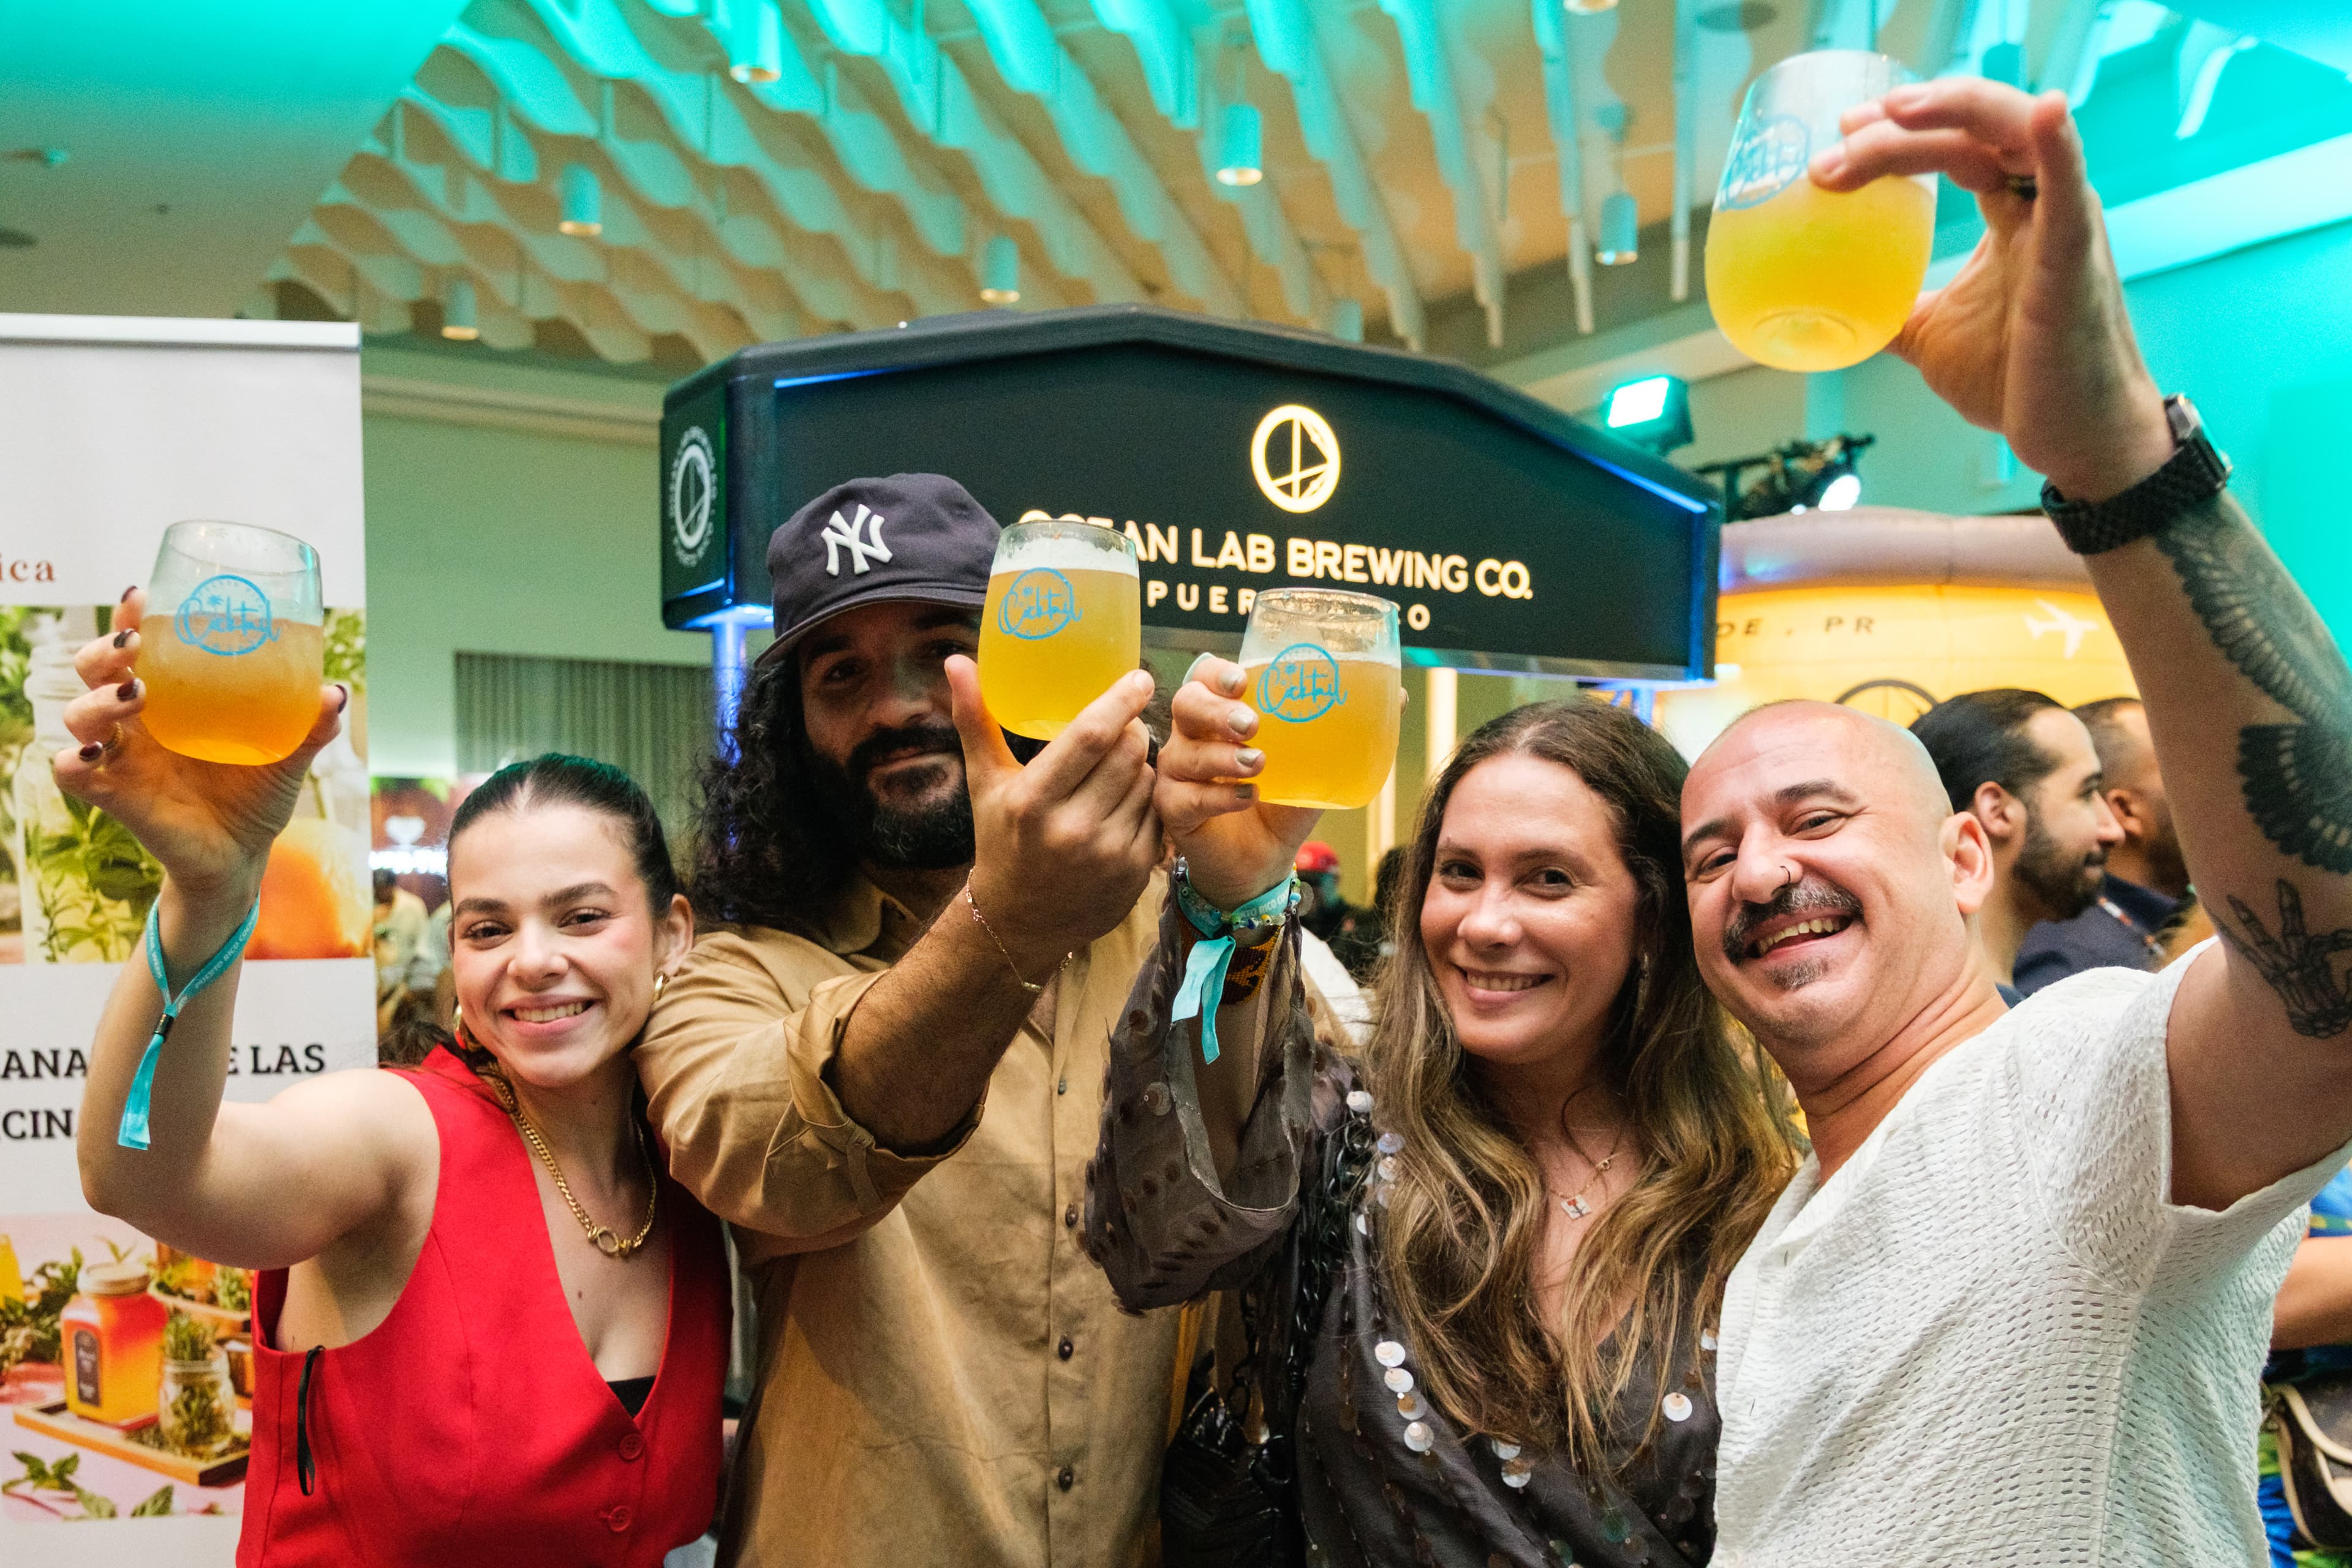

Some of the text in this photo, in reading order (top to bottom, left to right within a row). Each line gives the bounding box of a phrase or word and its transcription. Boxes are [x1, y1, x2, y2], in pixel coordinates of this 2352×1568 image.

[821, 503, 893, 576] NY
[1191, 528, 1276, 573] LAB
[1287, 537, 1469, 593] BREWING
[1474, 558, 1534, 600] CO.
[1147, 580, 1257, 615] PUER
[1825, 616, 1873, 635] PR
[250, 1044, 325, 1074] LAS
[2, 1109, 77, 1140] CIN
